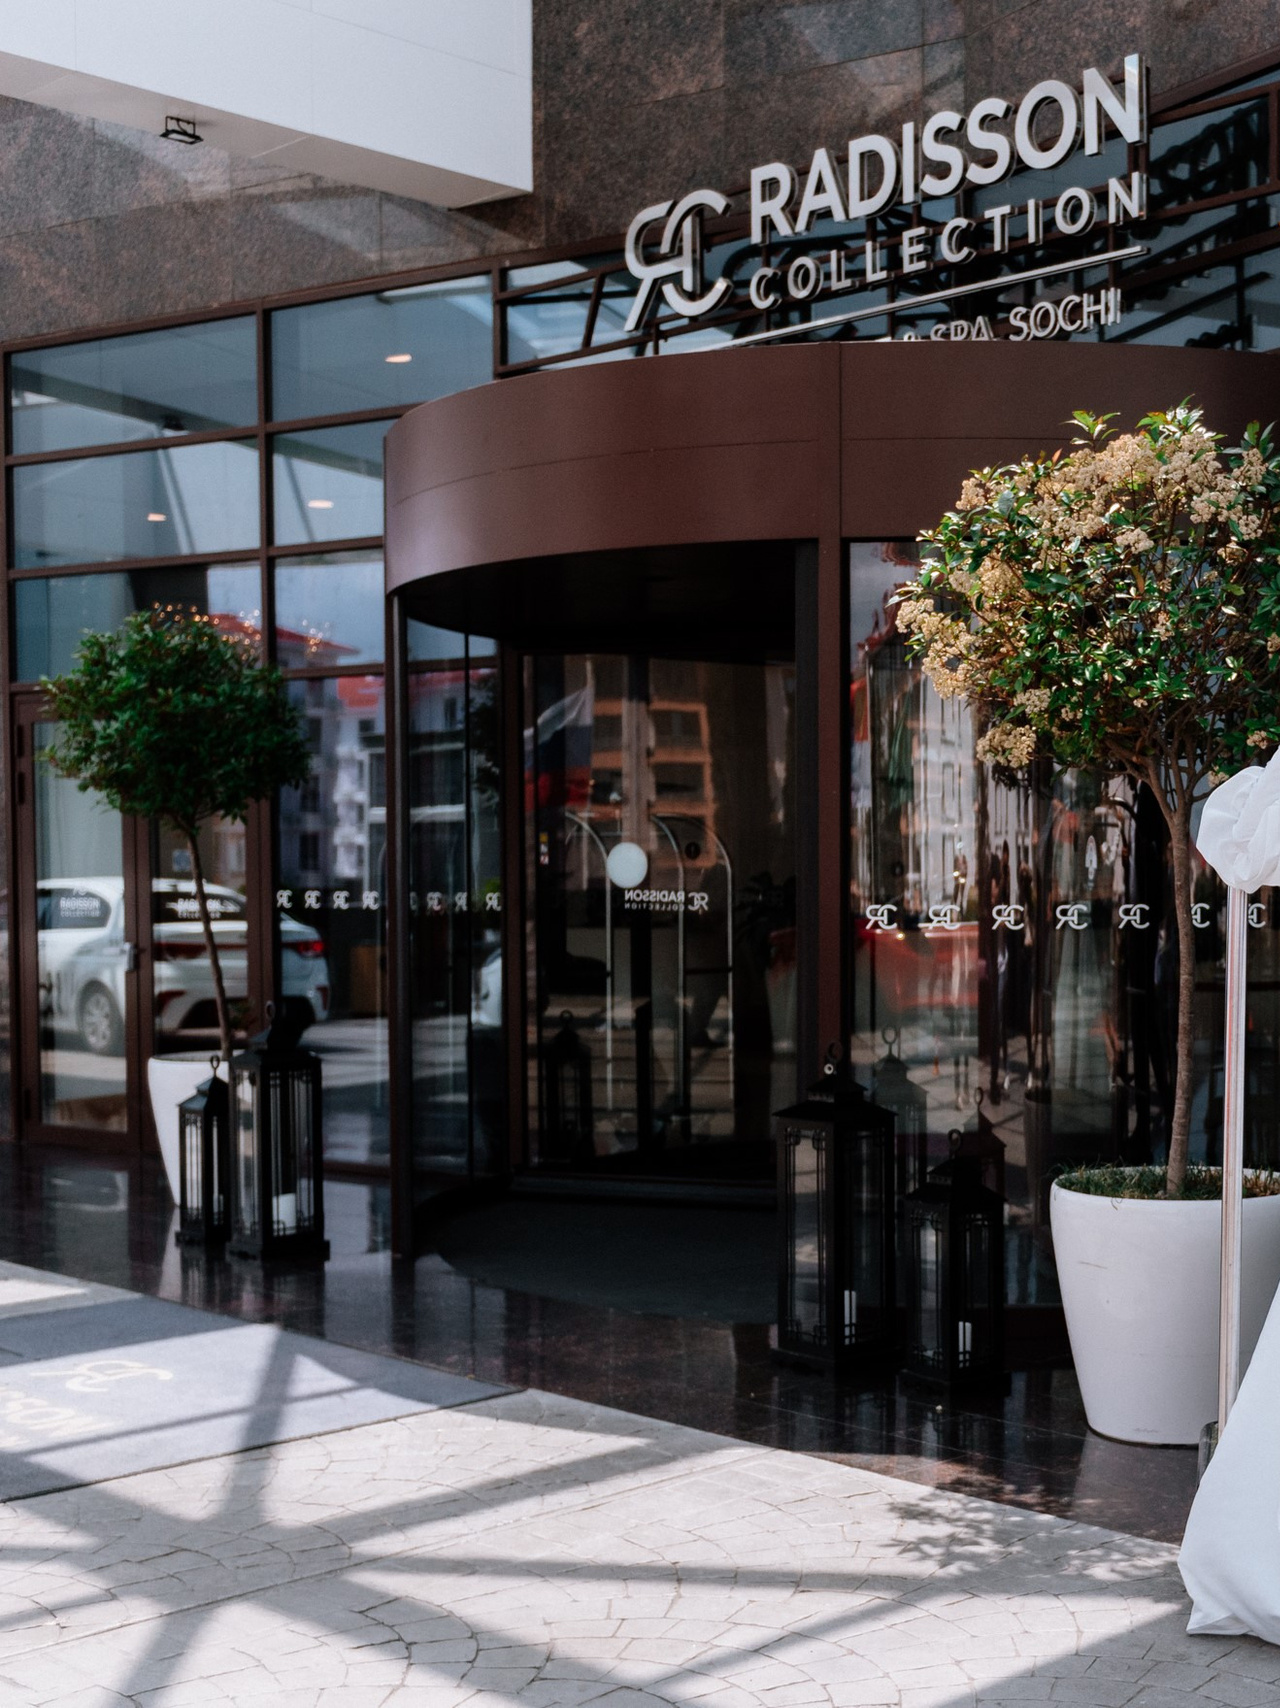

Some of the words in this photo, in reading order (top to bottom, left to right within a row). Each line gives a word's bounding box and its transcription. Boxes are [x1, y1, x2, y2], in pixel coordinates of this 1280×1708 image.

[750, 53, 1148, 245] RADISSON
[749, 171, 1148, 310] COLLECTION
[1009, 286, 1122, 342] SOCHI
